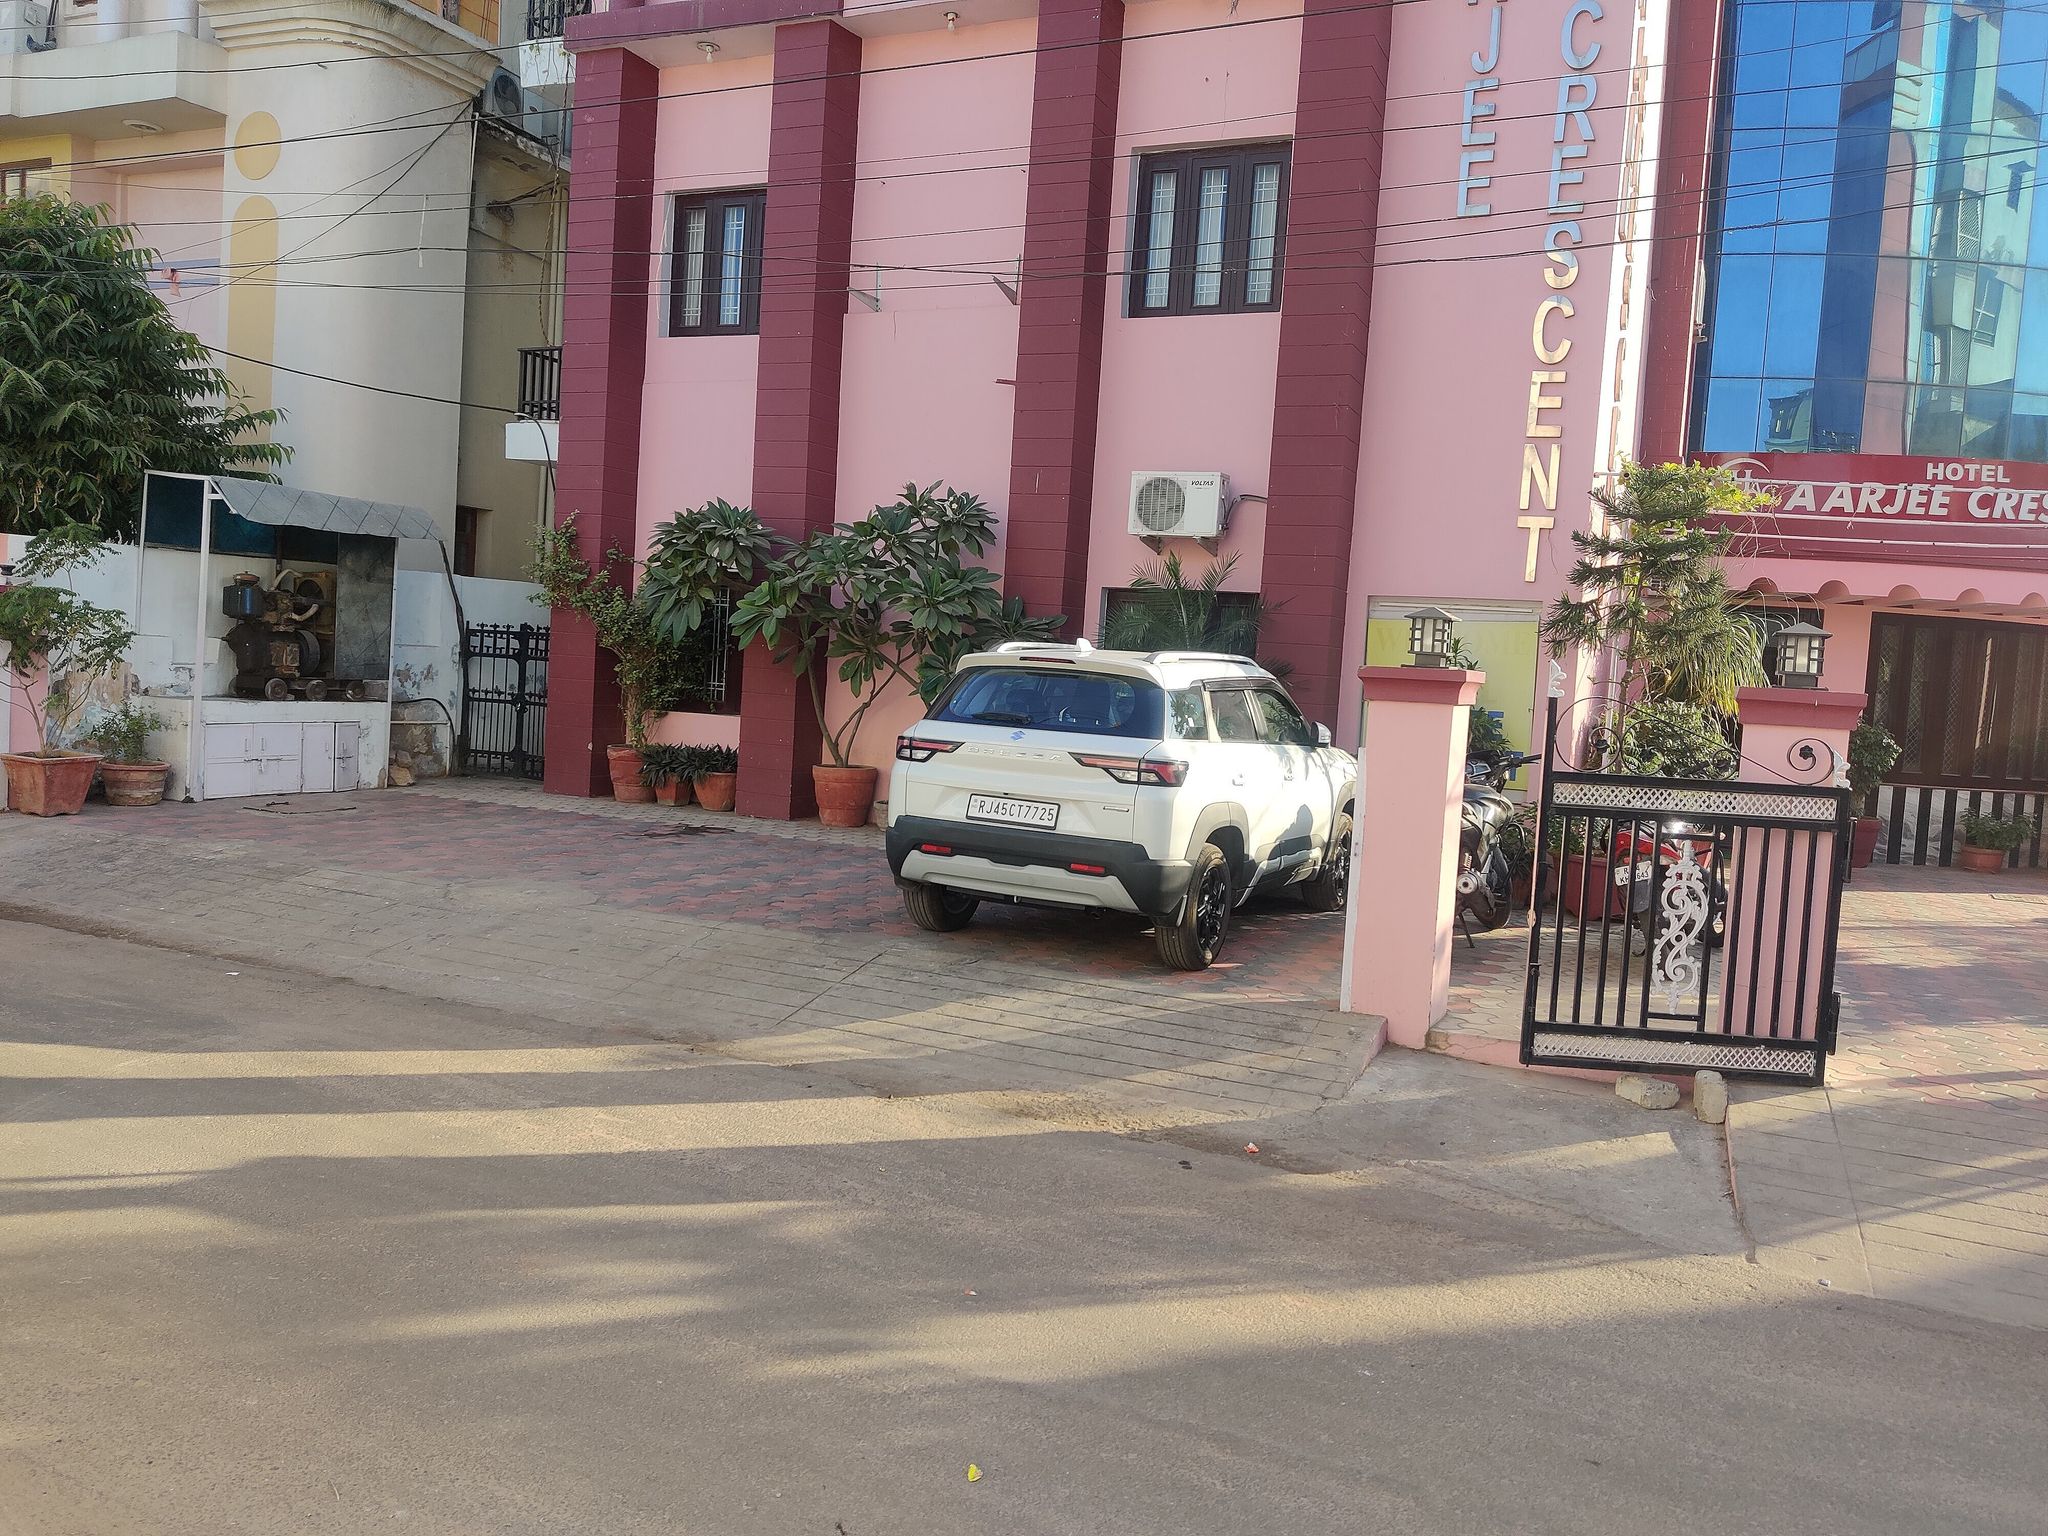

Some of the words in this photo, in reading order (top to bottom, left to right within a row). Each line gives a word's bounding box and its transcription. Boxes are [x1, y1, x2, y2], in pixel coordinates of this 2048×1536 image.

[1457, 0, 1504, 217] JEE
[1517, 0, 1604, 583] CRESCENT
[1926, 463, 2010, 483] HOTEL
[1783, 482, 1955, 516] AARJEE
[978, 800, 1054, 822] RJ45CT7725
